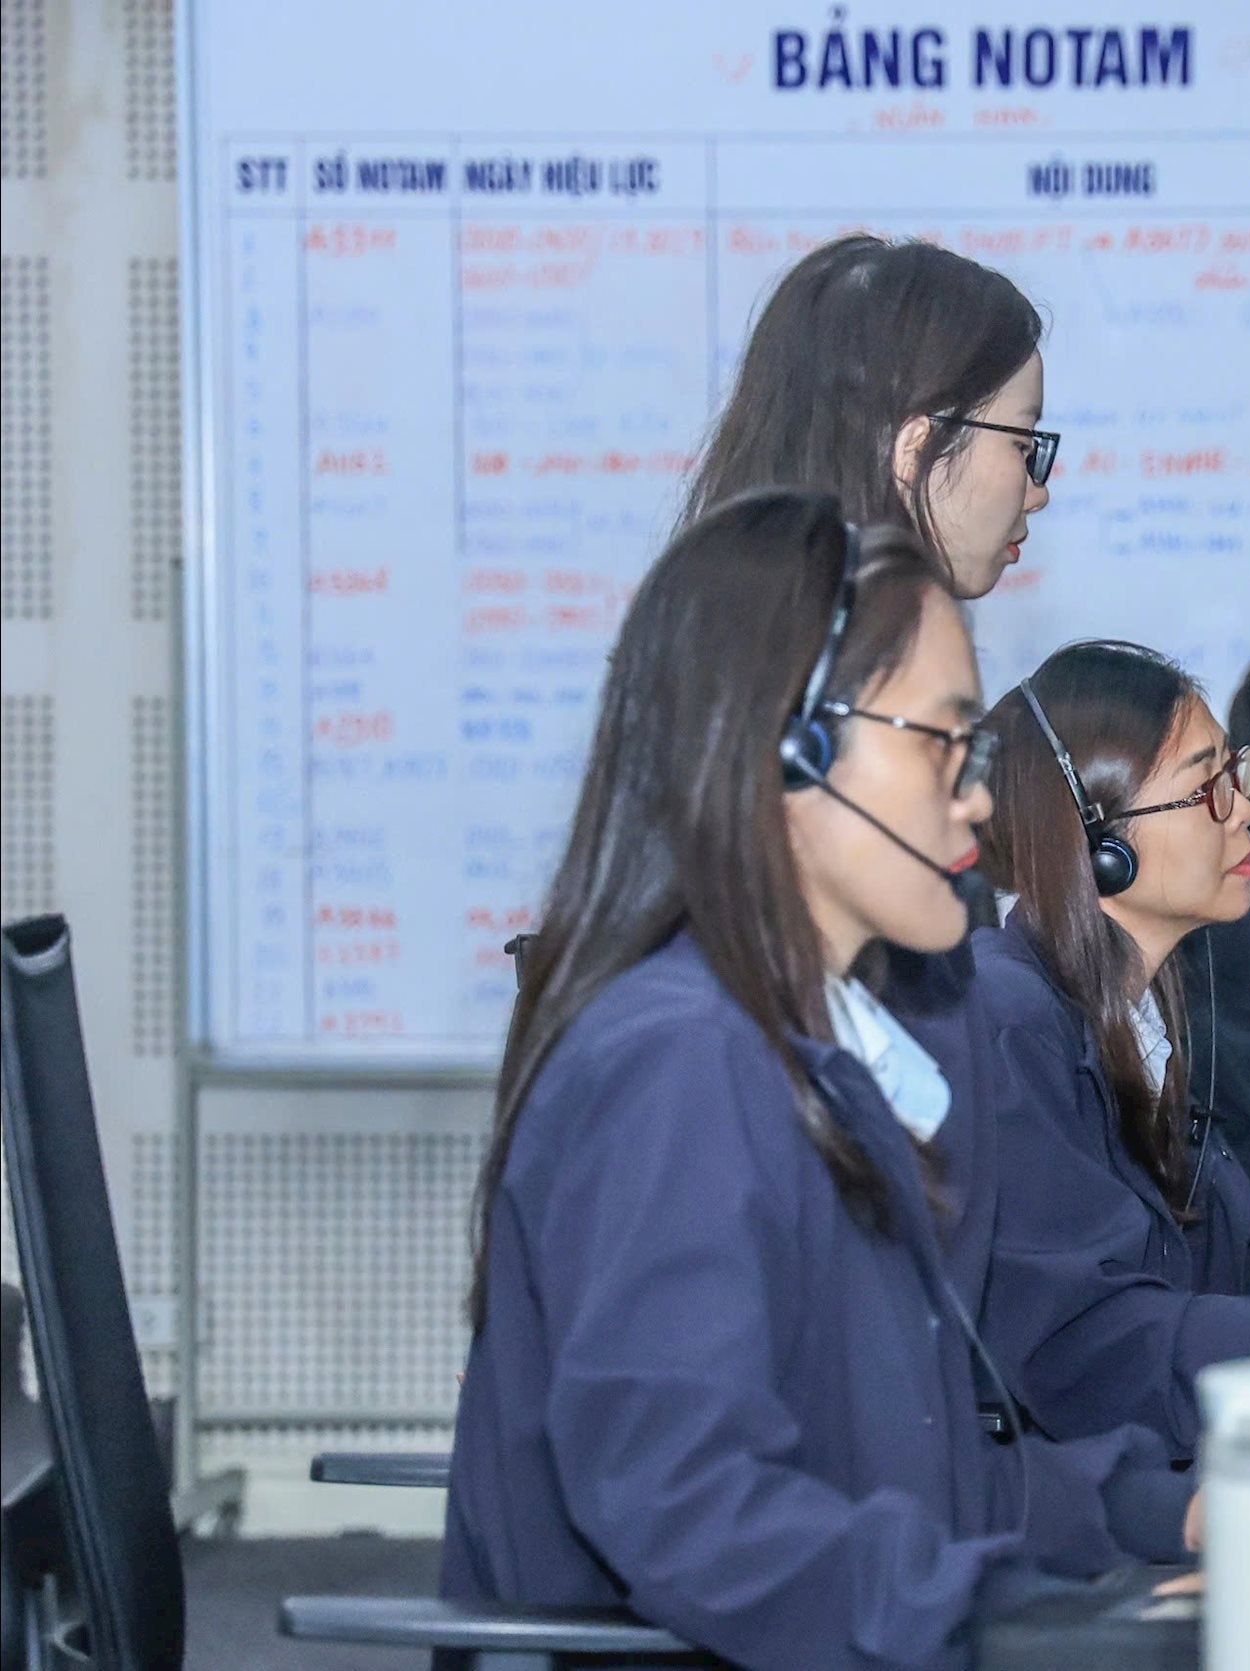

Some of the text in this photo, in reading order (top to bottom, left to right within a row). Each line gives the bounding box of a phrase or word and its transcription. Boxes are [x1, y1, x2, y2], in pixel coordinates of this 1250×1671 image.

[772, 5, 1192, 90] BẢNG NOTAM
[237, 157, 287, 193] STT
[315, 149, 348, 193] SỐ
